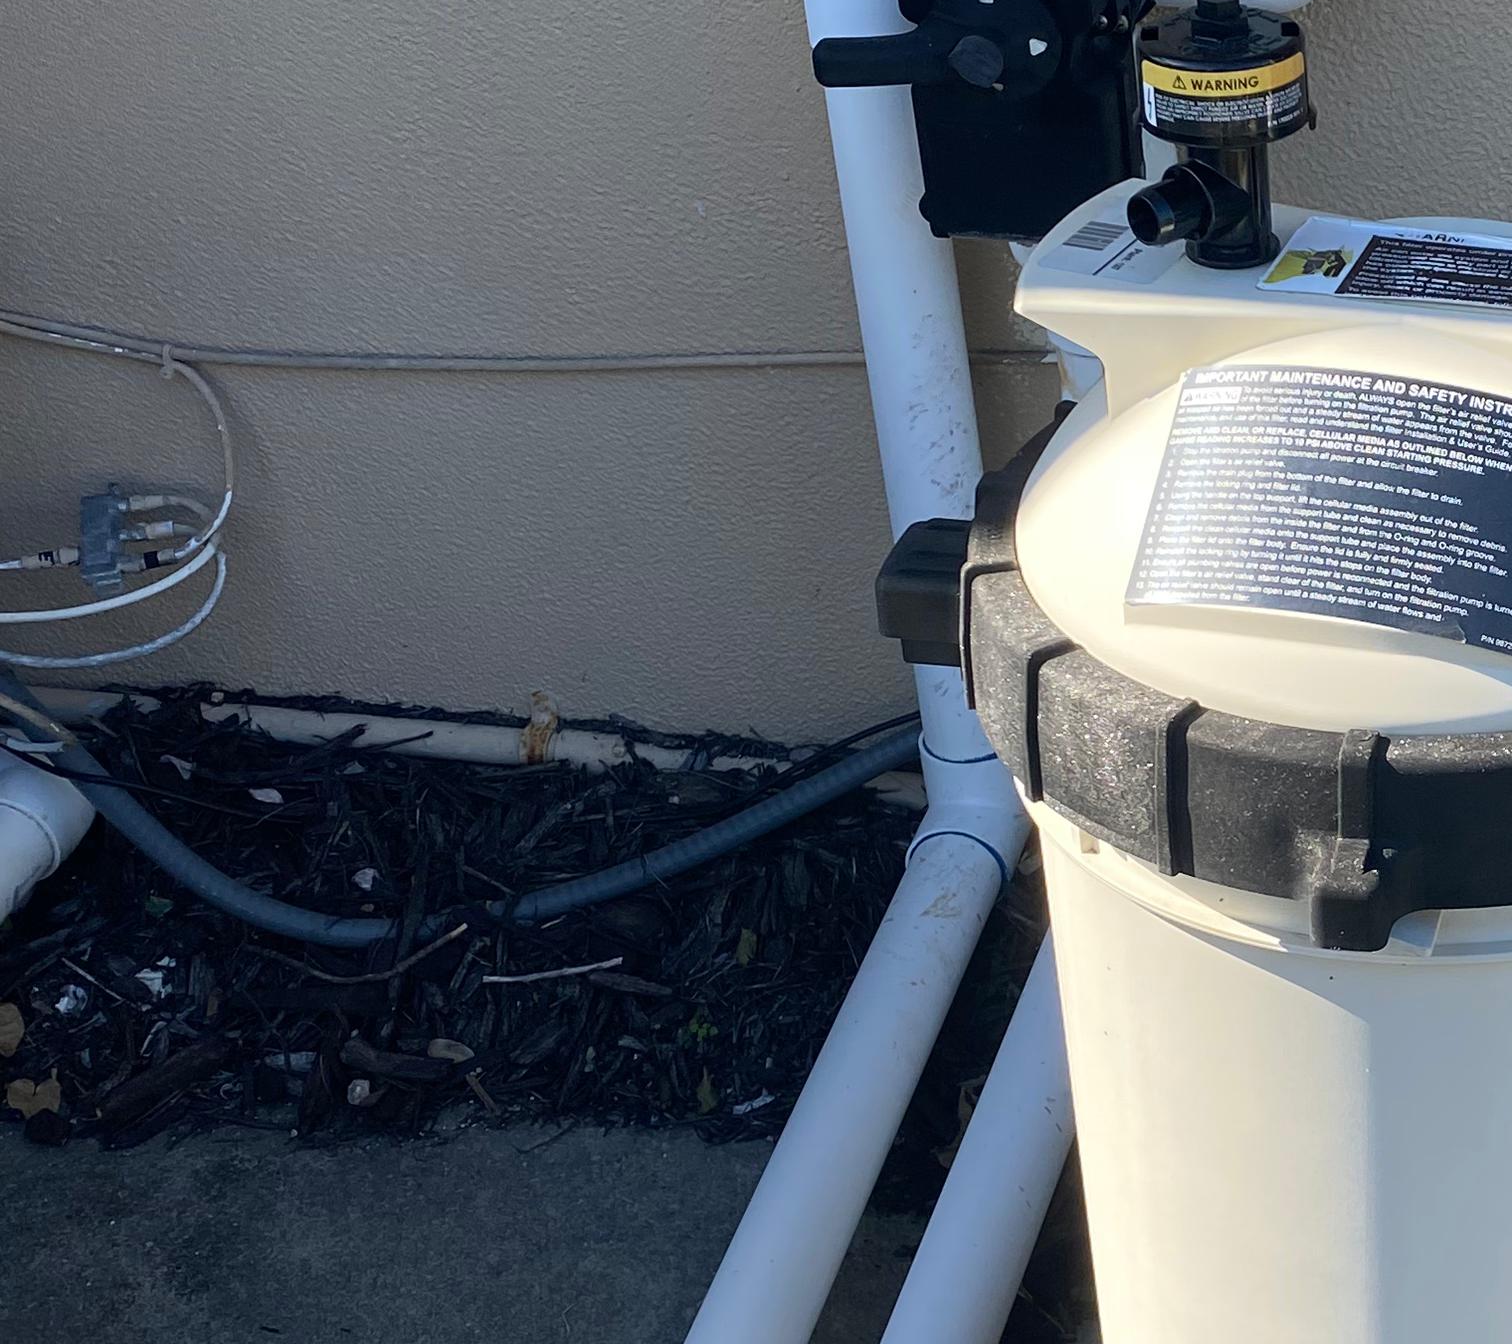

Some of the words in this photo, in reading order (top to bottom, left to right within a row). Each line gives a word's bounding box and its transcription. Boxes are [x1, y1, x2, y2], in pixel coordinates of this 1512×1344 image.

[1189, 76, 1260, 91] WARNING
[1195, 371, 1268, 384] IMPORTANT
[1270, 371, 1372, 390] MAINTENANCE
[1373, 379, 1406, 394] AND
[1409, 384, 1468, 406] SAFETY
[1302, 387, 1323, 398] injury
[1359, 394, 1395, 405] ALWAYS
[1395, 400, 1417, 408] open
[1418, 402, 1431, 412] the
[1458, 410, 1469, 418] air
[1470, 413, 1491, 423] relief
[1309, 416, 1324, 425] and
[1325, 419, 1369, 430] understand
[1370, 423, 1384, 433] the
[1457, 438, 1484, 451] User's
[1315, 408, 1341, 418] steady
[1342, 411, 1370, 421] stream
[1381, 416, 1404, 425] water
[1404, 419, 1438, 431] appears
[1438, 424, 1458, 435] from
[1459, 430, 1473, 439] the
[1420, 411, 1436, 422] The
[1449, 418, 1471, 428] relief
[1471, 423, 1493, 433] valve
[1251, 426, 1265, 434] OR
[1309, 429, 1356, 442] CELLULAR
[1357, 434, 1386, 446] MEDIA
[1386, 438, 1400, 449] AS
[1401, 441, 1449, 457] OUTLINED
[1449, 451, 1484, 465] BELOW
[1484, 458, 1512, 472] WHEN
[1281, 437, 1294, 445] TO
[1295, 438, 1305, 446] 10
[1305, 438, 1320, 448] PSI
[1320, 440, 1354, 452] ABOVE
[1353, 444, 1386, 456] CLEAN
[1386, 449, 1432, 464] STARTING
[1433, 458, 1485, 476] PRESSURE.
[1330, 453, 1356, 463] power
[1323, 499, 1352, 509] cellular
[1352, 503, 1379, 514] media
[1379, 507, 1419, 523] assembly
[1419, 514, 1434, 524] out
[1360, 515, 1382, 525] clean
[1394, 522, 1437, 538] necessary
[1448, 532, 1480, 546] remove
[1290, 541, 1319, 552] Ensure
[1377, 542, 1400, 553] place
[1416, 550, 1456, 566] assembly
[1456, 558, 1473, 569] into
[1393, 532, 1420, 546] O-ring
[1438, 540, 1465, 556] O-ring
[1465, 548, 1497, 563] groove.
[1340, 560, 1363, 571] stops
[1307, 567, 1333, 577] power
[1342, 572, 1393, 588] reconnected
[1425, 586, 1460, 602] filtration
[1460, 595, 1485, 609] pump
[1309, 591, 1338, 604] steady
[1338, 596, 1367, 607] stream
[1378, 602, 1402, 613] water
[1402, 606, 1425, 618] flows
[1409, 595, 1443, 610] filtration
[1443, 604, 1469, 617] pump.
